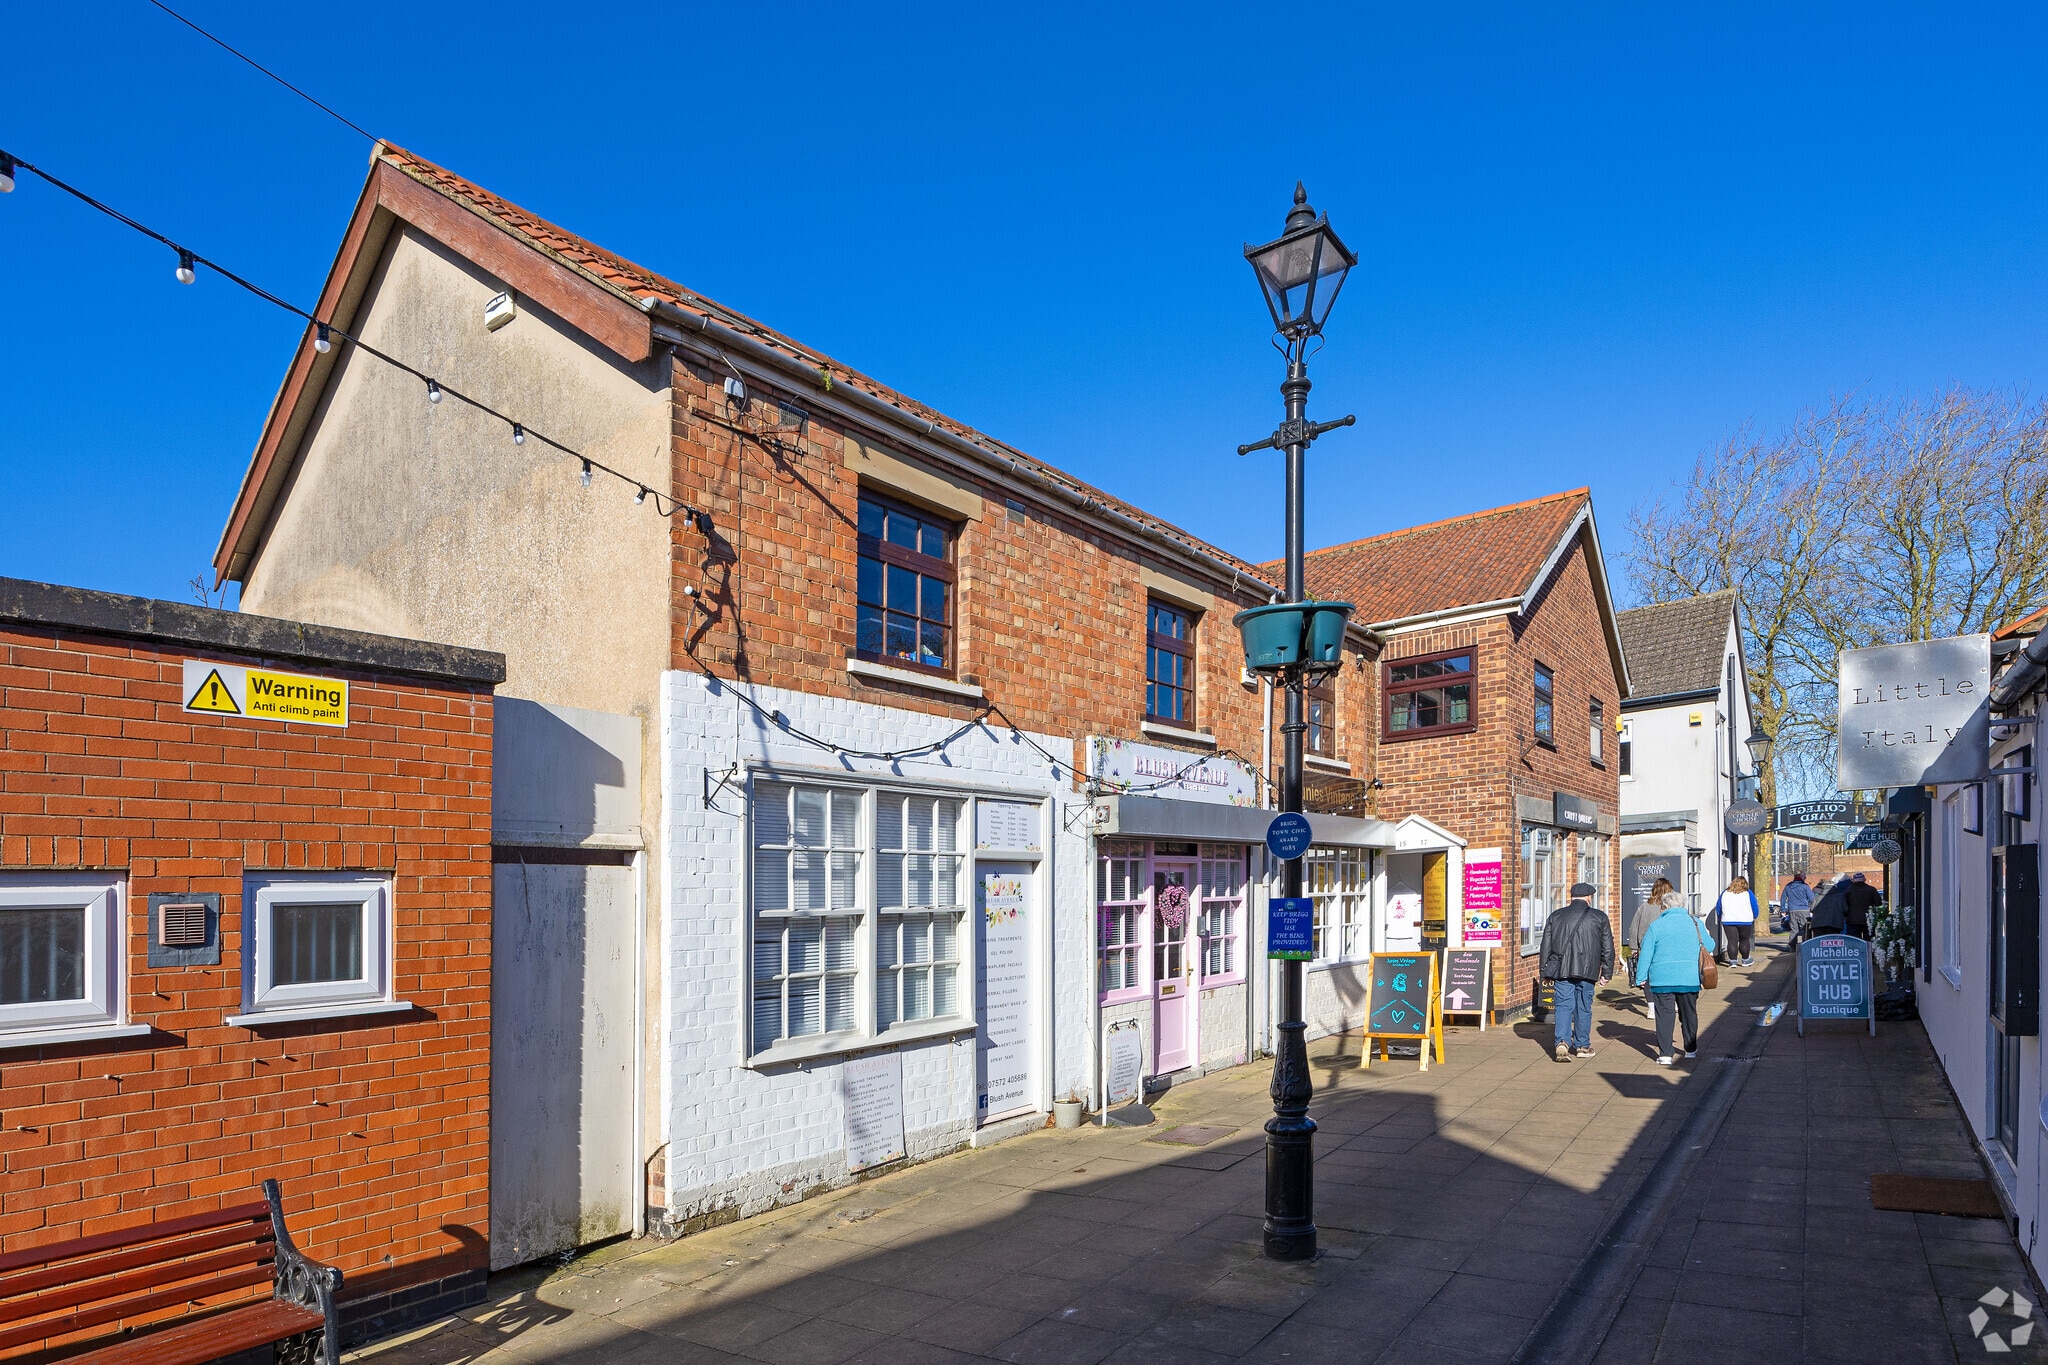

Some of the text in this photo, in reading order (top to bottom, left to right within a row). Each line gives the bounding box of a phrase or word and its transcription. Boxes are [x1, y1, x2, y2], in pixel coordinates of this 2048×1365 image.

[252, 677, 341, 706] Warning
[1853, 678, 1973, 705] Little
[253, 701, 340, 718] Anti climb paint
[1862, 725, 1962, 748] Italy
[1136, 756, 1179, 780] BLUSH
[1184, 765, 1229, 786] AVENUE
[1812, 948, 1859, 957] Michelles
[1810, 964, 1859, 980] STYLE
[1819, 984, 1851, 1000] HUB
[1812, 1006, 1859, 1015] Boutique
[846, 1063, 871, 1074] BLUSH
[872, 1056, 900, 1068] AVENUE
[988, 1078, 1005, 1088] 07572
[1007, 1073, 1027, 1083] 405686
[851, 1088, 878, 1098] PROFESSIONAL
[851, 1094, 874, 1102] APPLICATION
[990, 1089, 1023, 1103] Blush Avenue
[851, 1101, 875, 1109] DERMAPLANE
[874, 1102, 894, 1111] INJECTIONS
